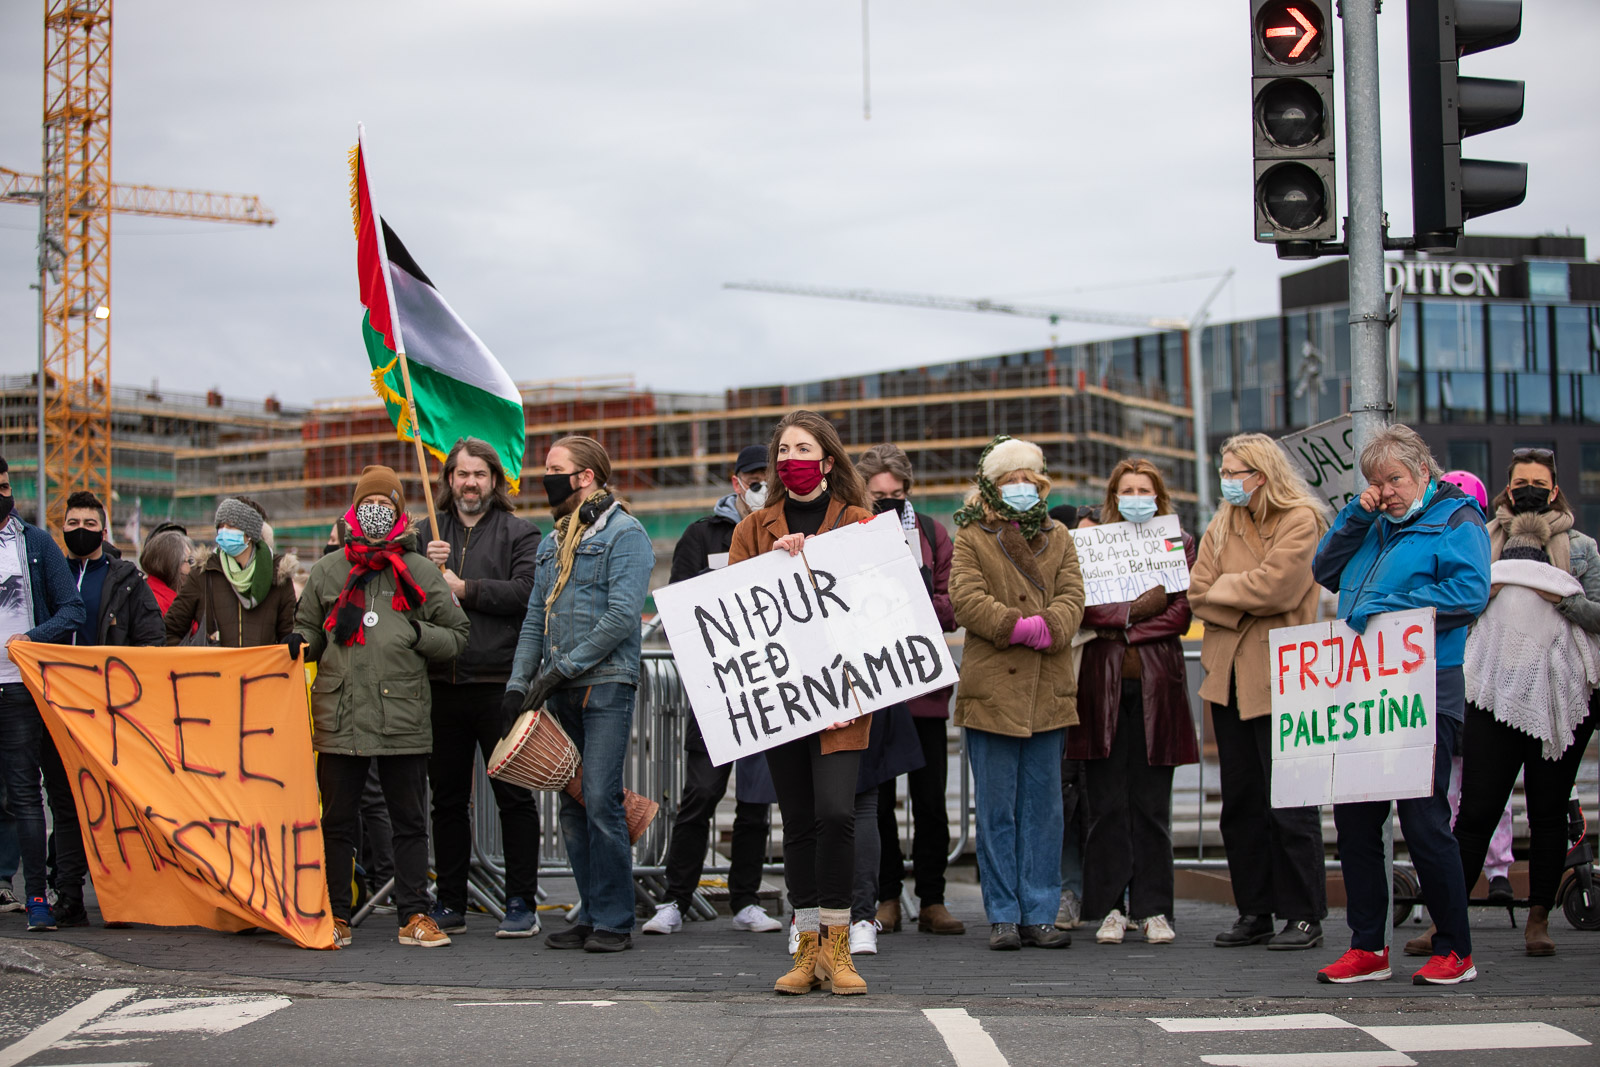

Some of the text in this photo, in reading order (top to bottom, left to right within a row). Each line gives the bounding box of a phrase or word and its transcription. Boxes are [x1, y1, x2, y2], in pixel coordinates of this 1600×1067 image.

[1076, 540, 1163, 565] o Be Arab OR
[1134, 522, 1167, 541] Have
[1113, 562, 1127, 575] To
[1129, 559, 1144, 574] Be
[1146, 557, 1186, 572] Human
[694, 569, 851, 658] NIÐUR
[713, 642, 789, 693] MEÐ
[725, 635, 943, 747] HERNÁMIÐ
[38, 656, 290, 789] FREE
[1280, 688, 1428, 752] PALESTÍNA
